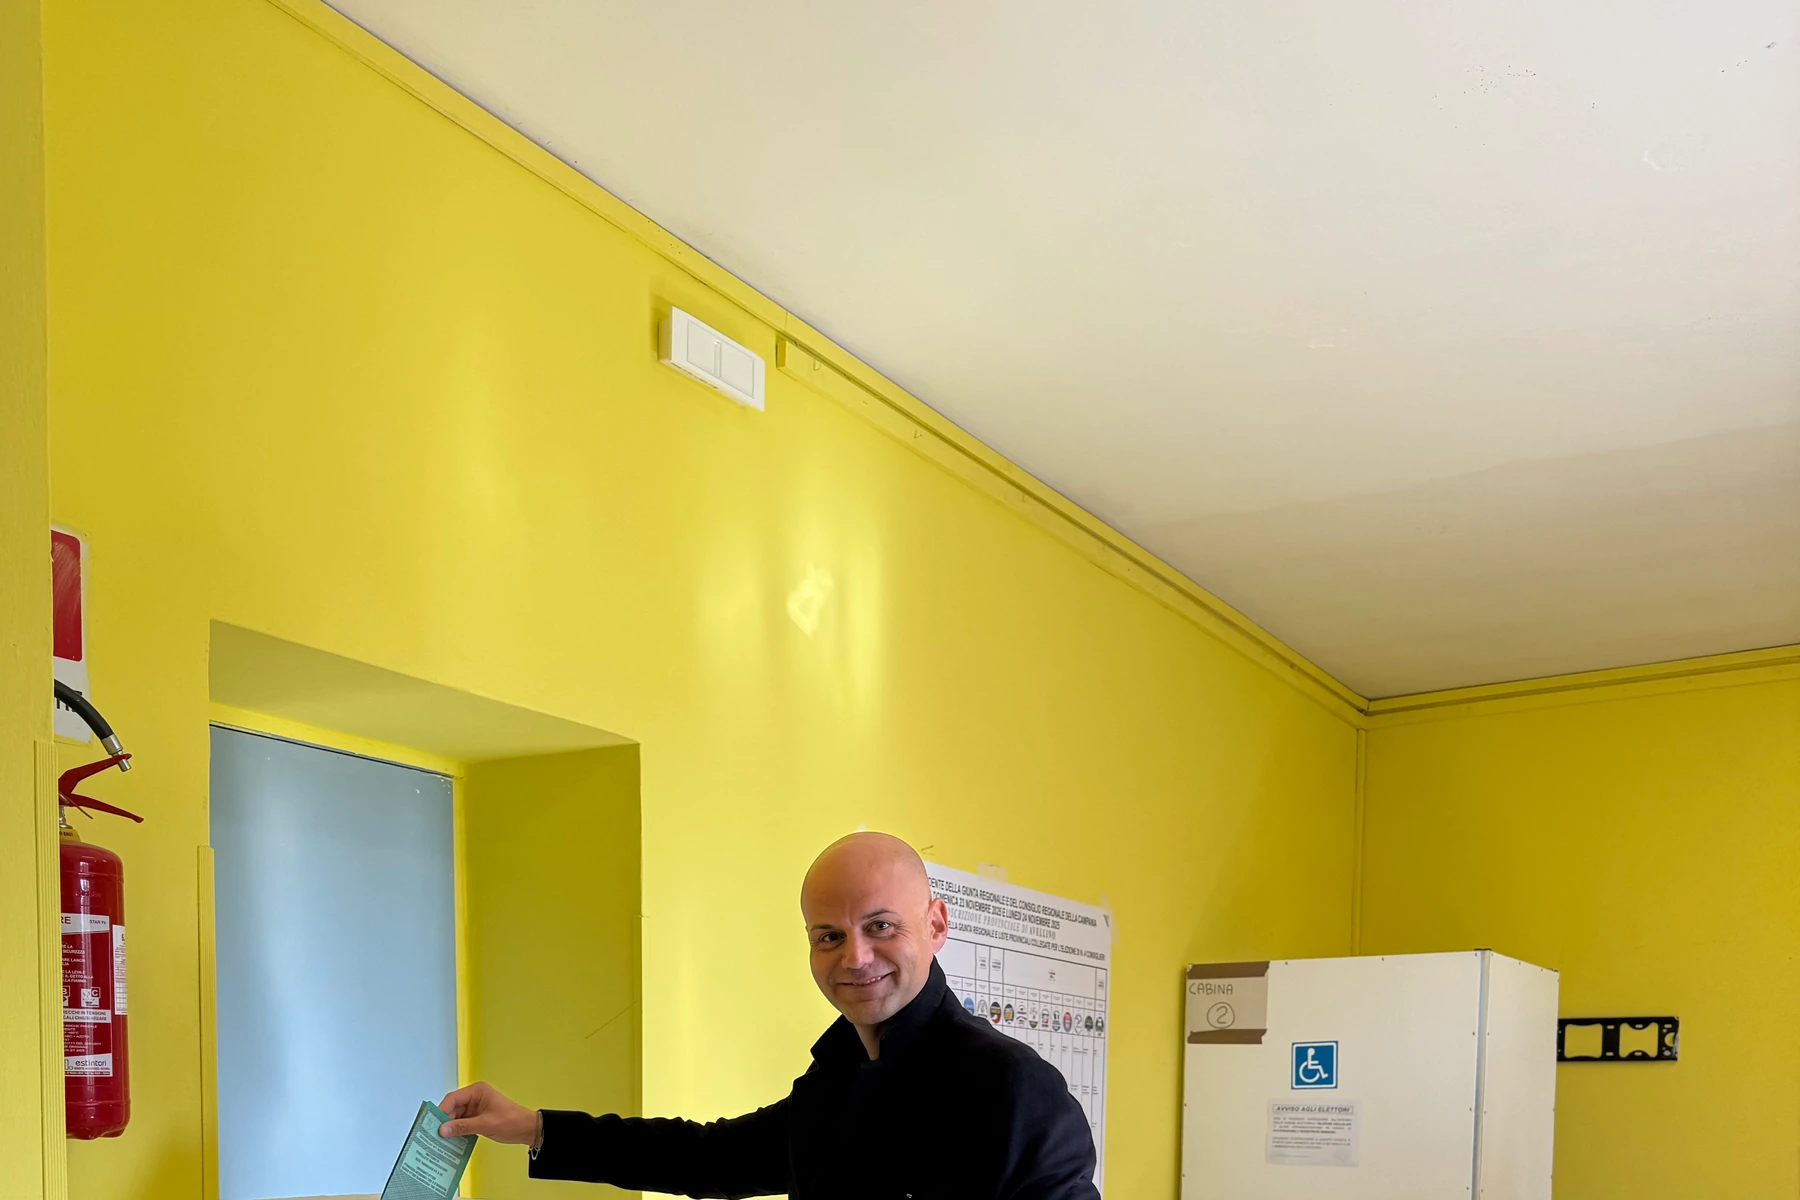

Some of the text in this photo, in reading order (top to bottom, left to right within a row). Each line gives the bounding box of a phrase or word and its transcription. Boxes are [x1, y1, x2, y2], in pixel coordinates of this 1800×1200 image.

[946, 881, 960, 894] DELLA
[962, 885, 978, 898] GIUNTA
[980, 889, 1005, 906] REGIONALE
[1019, 900, 1041, 914] CONSIGLIO
[1042, 905, 1064, 920] REGIONALE
[966, 899, 991, 914] NOVEMBRE
[1028, 914, 1050, 928] NOVEMBRE
[1188, 982, 1234, 996] CABINA
[1216, 1005, 1228, 1024] 2
